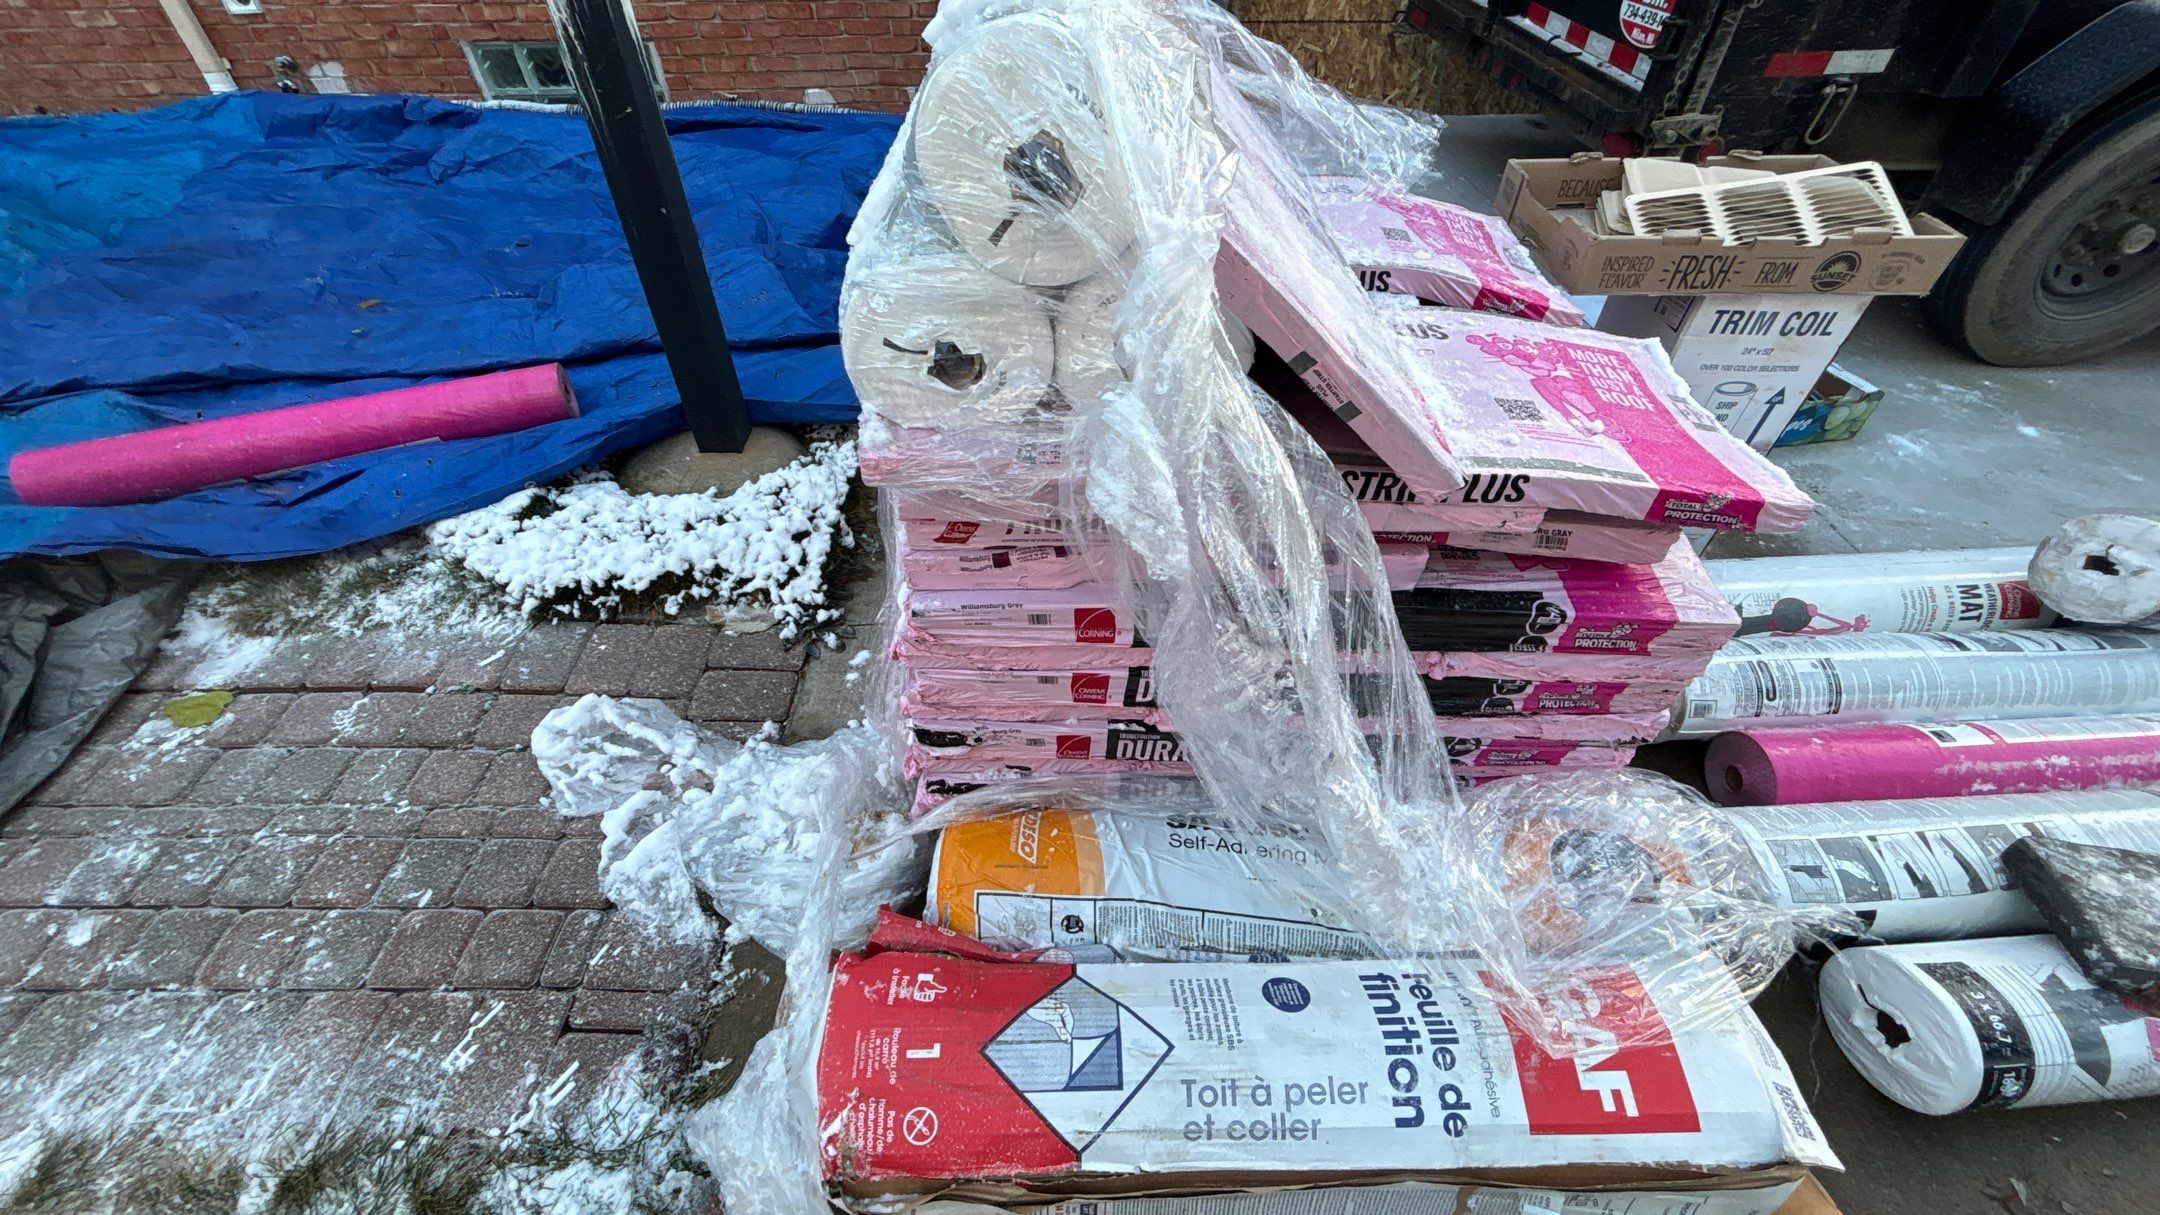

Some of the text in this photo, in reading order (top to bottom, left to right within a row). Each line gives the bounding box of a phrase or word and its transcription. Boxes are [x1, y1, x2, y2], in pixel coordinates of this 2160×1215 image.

[1601, 256, 1655, 272] INSPIRED
[1667, 255, 1738, 289] FRESH
[1754, 261, 1800, 284] FROM
[1359, 270, 1392, 292] US
[1599, 272, 1645, 288] FLAVOR
[1810, 271, 1857, 283] SUNSET
[1709, 309, 1780, 337] TRIM
[1779, 311, 1839, 337] COIL
[1567, 347, 1626, 370] MORE
[1700, 364, 1719, 372] OVER
[1733, 364, 1757, 372] COLOR
[1576, 360, 1637, 385] THAN
[1588, 375, 1646, 397] JUST A
[1595, 387, 1656, 412] ROOF
[1715, 401, 1738, 410] SHIP
[1715, 414, 1728, 422] ND
[1341, 469, 1531, 503] STRI LUS
[1664, 510, 1739, 523] PROTECTION
[1671, 502, 1698, 510] TOTAL
[1551, 529, 1574, 537] GRAY
[1955, 584, 1984, 622] MAT
[1078, 629, 1115, 638] CORNING
[1574, 638, 1637, 649] PROTECTION
[1116, 740, 1190, 761] DURA
[1169, 833, 1307, 866] Self-Adering
[1971, 991, 1985, 1000] 3
[1182, 1005, 1193, 1033] garages
[1230, 1005, 1237, 1014] de
[1196, 1023, 1205, 1041] abris
[1215, 1024, 1224, 1046] zones
[1217, 997, 1231, 1033] granuleuse
[1226, 1034, 1235, 1051] SBS
[889, 1027, 902, 1085] Rouleau de
[906, 1043, 940, 1059] 1
[1359, 971, 1425, 1128] finition
[1180, 1075, 1369, 1113] Toit à peler
[1438, 1083, 1472, 1138] de
[886, 1110, 896, 1143] Pas de
[1182, 1112, 1321, 1142] et coller
